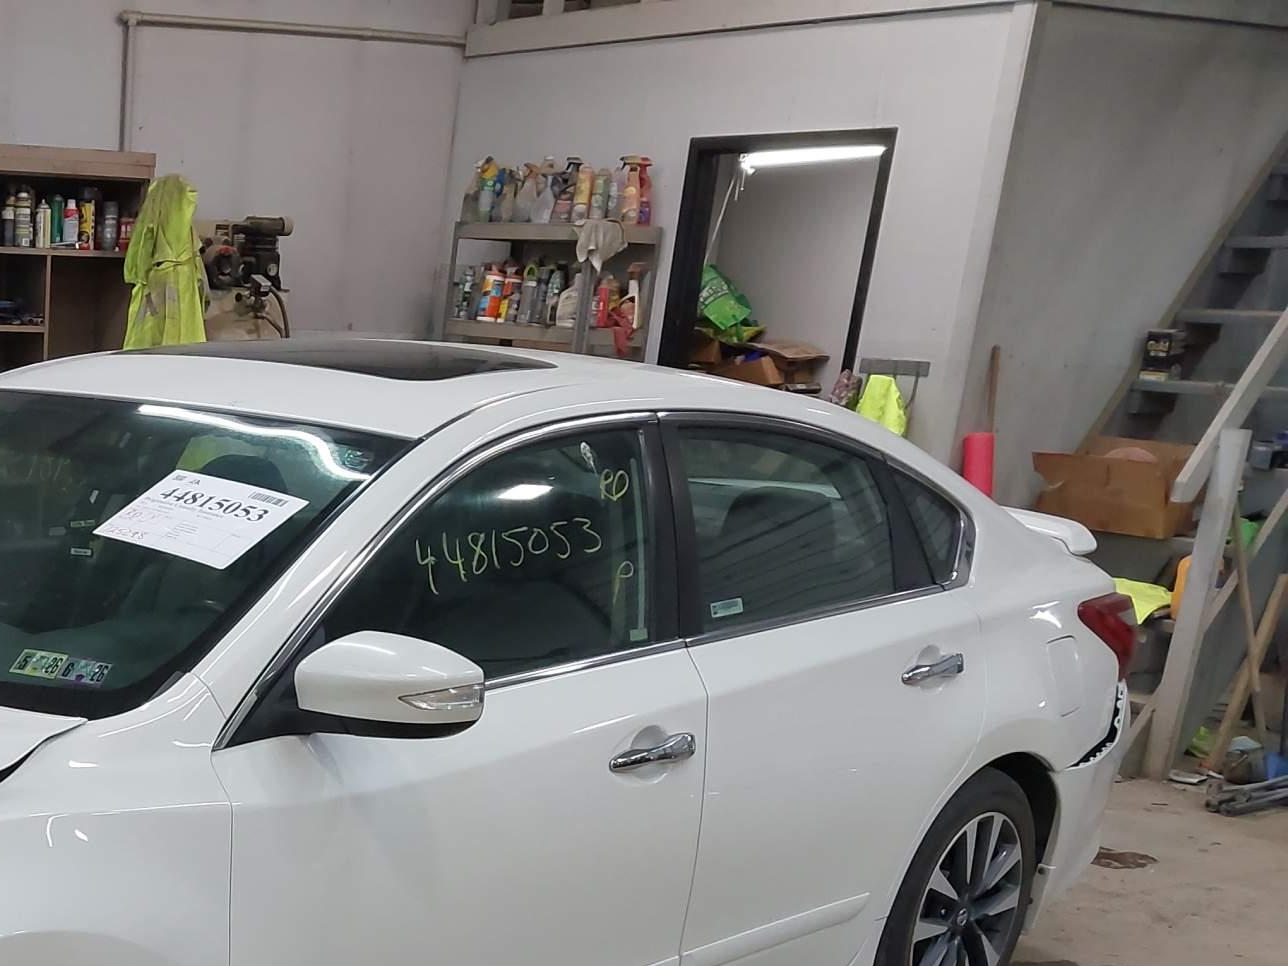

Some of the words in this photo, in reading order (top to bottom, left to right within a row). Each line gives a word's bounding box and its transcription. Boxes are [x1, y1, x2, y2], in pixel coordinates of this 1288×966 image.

[160, 487, 270, 522] 44815053
[415, 517, 602, 595] 44815053
[44, 657, 63, 674] 26
[62, 662, 75, 677] 6
[89, 664, 109, 682] 26
